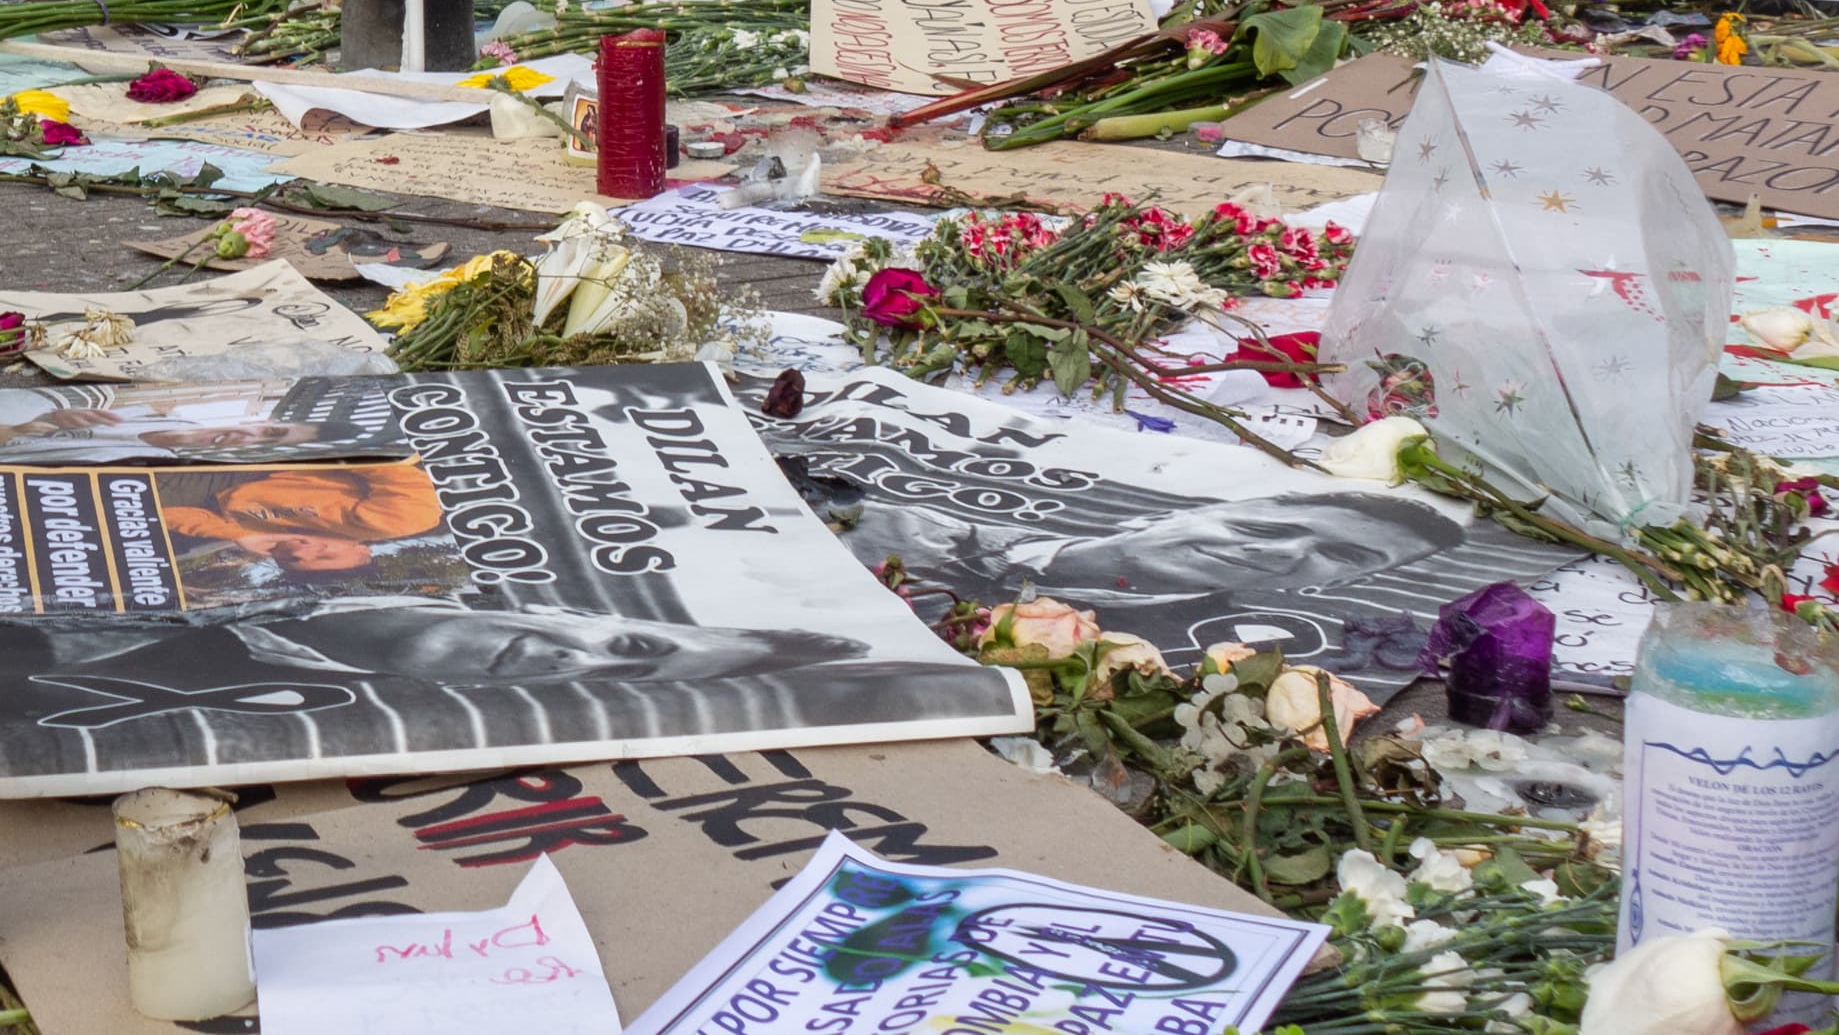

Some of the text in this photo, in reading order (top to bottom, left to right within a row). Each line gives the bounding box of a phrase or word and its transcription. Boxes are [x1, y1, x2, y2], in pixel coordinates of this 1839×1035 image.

[1645, 69, 1823, 115] ESTA
[387, 381, 558, 587] CONTIGO!
[502, 379, 678, 577] ESTAMOS
[623, 406, 780, 537] DILAN
[26, 479, 104, 609] por defender
[108, 479, 169, 607] Gracias valiente
[1687, 775, 1730, 792] VELON
[1733, 783, 1750, 795] DE
[1752, 784, 1778, 796] LOS
[711, 870, 901, 1035] POR SIEMPRE
[948, 917, 1015, 946] DE
[1017, 941, 1072, 960] Y
[1126, 916, 1195, 945] TU
